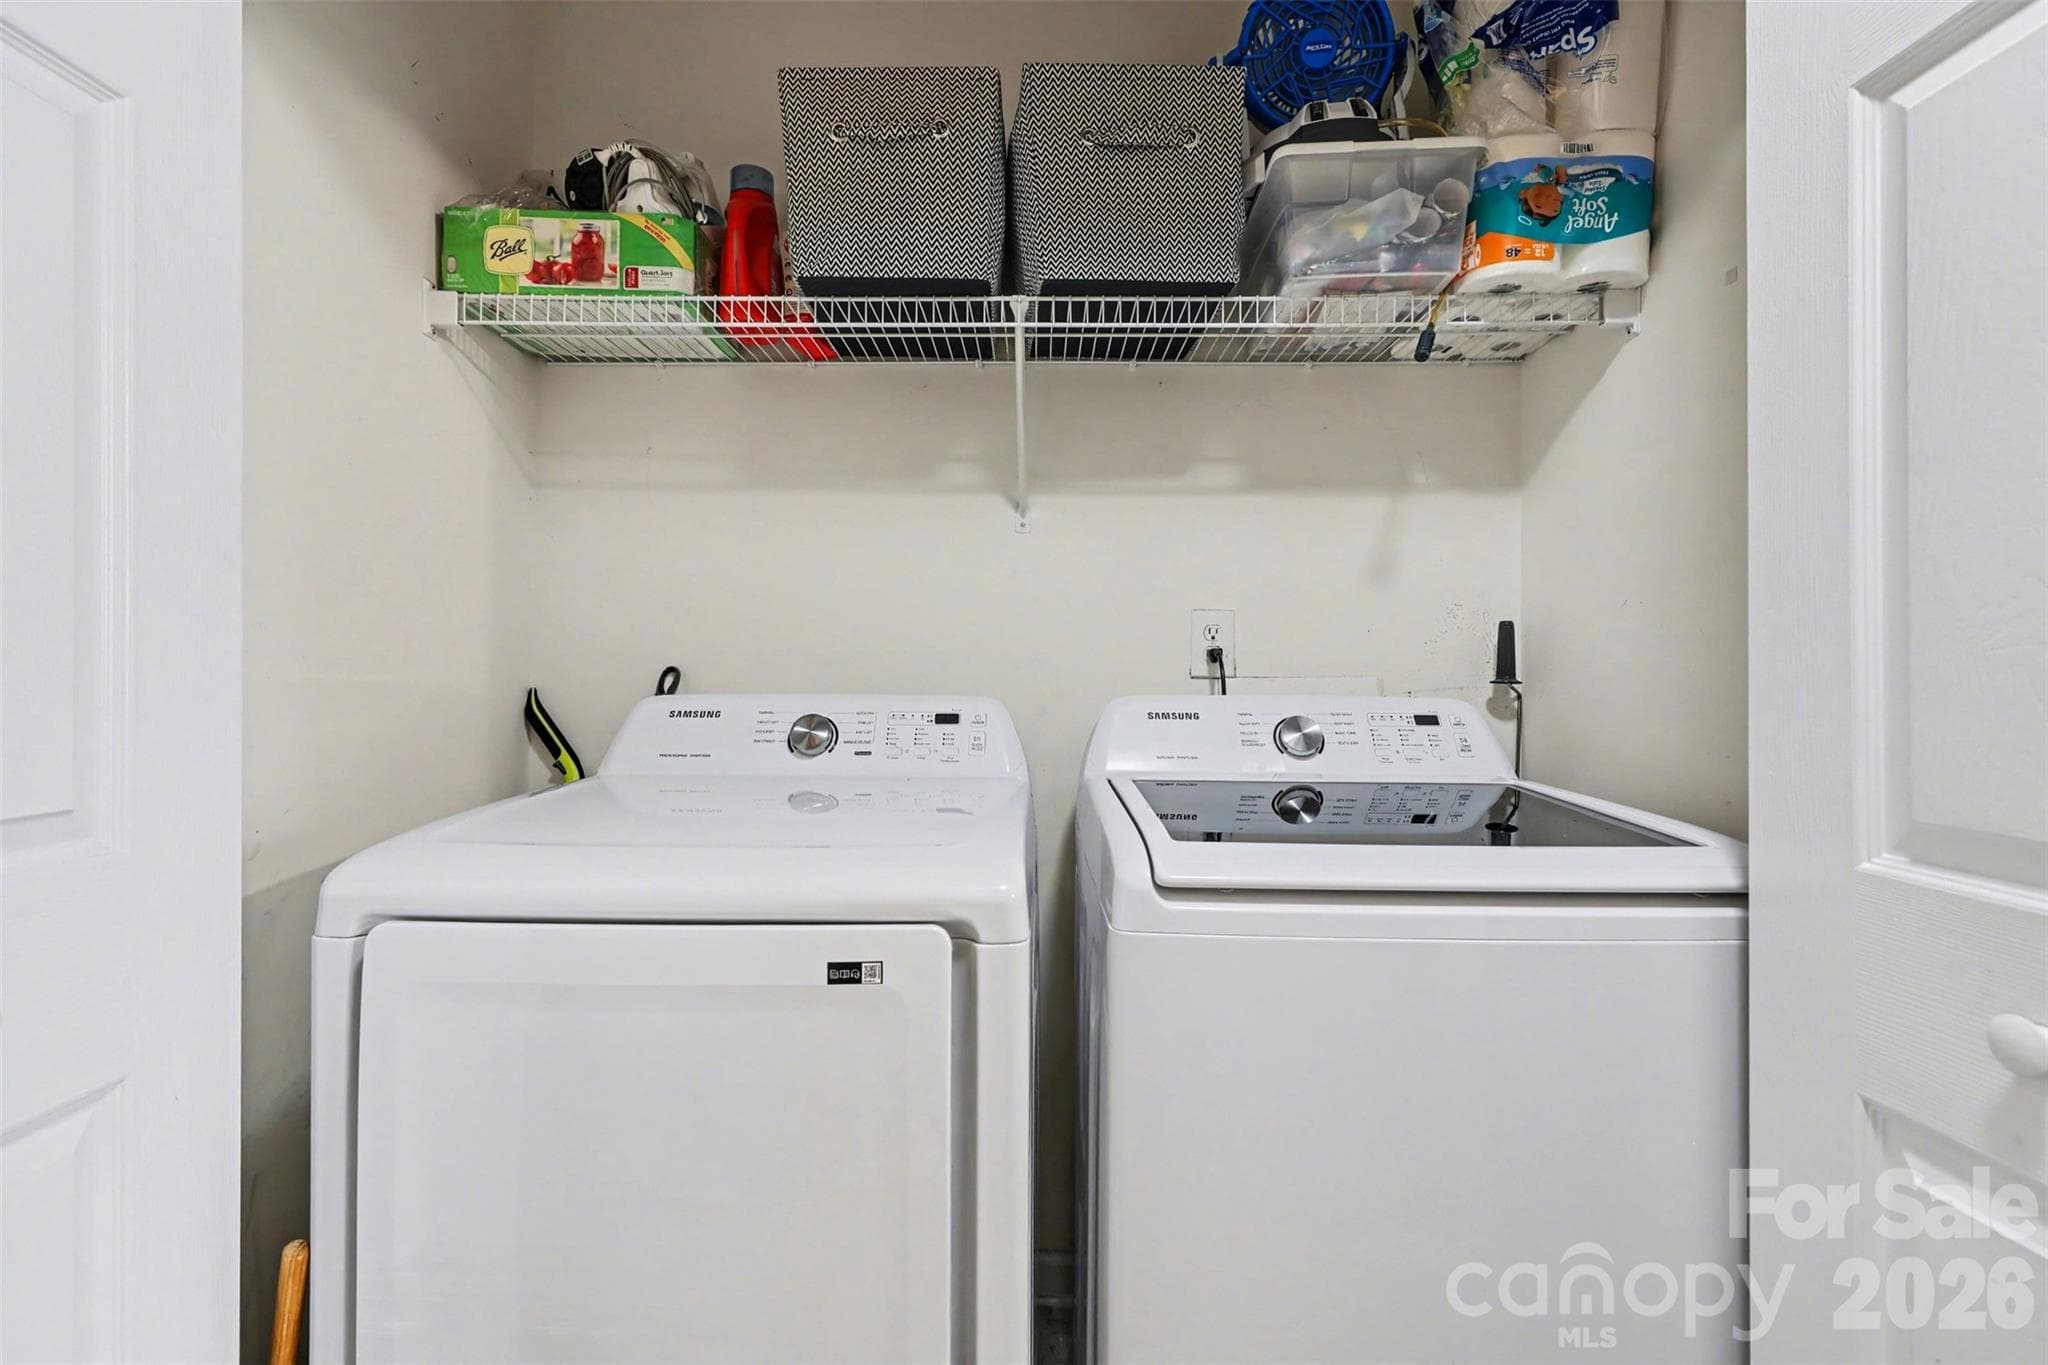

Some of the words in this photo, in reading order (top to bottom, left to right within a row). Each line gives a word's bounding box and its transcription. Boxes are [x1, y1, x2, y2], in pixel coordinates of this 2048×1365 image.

[1572, 196, 1608, 215] Soft
[1564, 212, 1618, 233] Angel
[490, 238, 527, 261] Ball
[1505, 247, 1522, 258] 48
[668, 710, 721, 719] SAMSUNG
[1147, 711, 1200, 720] SAMSUNG
